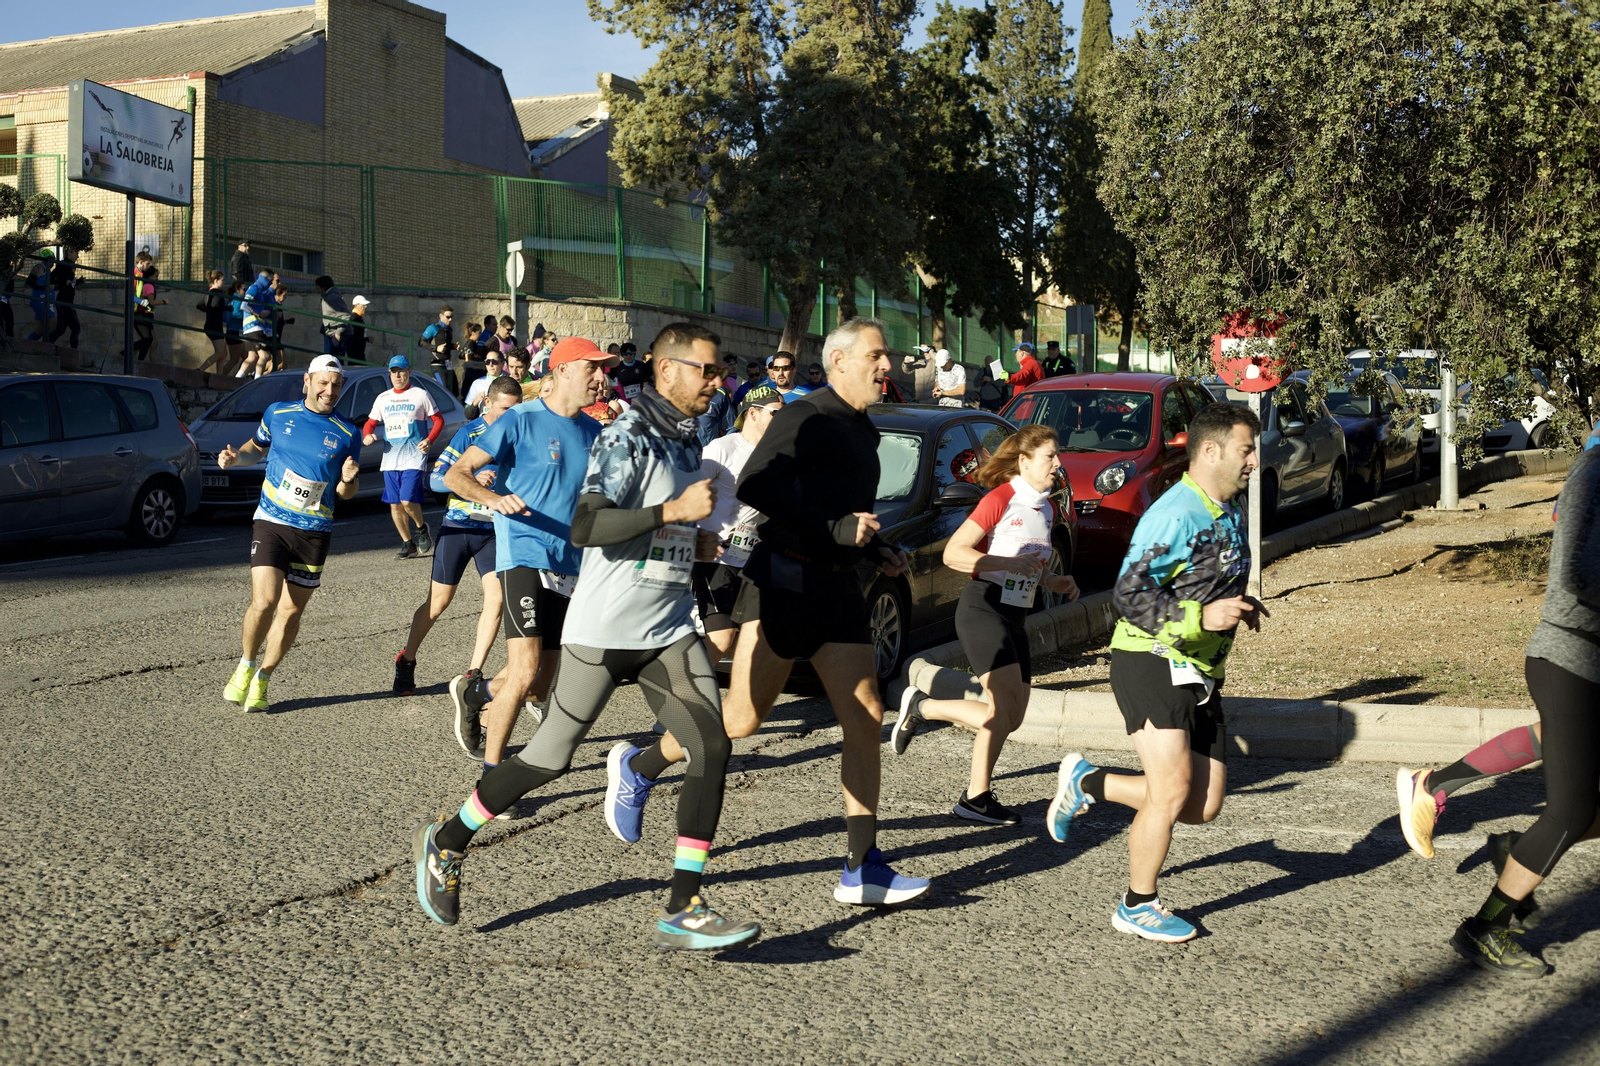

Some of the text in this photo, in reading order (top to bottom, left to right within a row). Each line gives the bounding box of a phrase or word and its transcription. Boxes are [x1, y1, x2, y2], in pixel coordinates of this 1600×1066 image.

[124, 132, 144, 143] DEPORTIVAS
[144, 139, 164, 150] MUNICIPALES
[100, 135, 174, 173] LA SALOBREJA
[384, 404, 416, 413] MADRID
[294, 486, 310, 498] 98
[668, 546, 692, 562] 112
